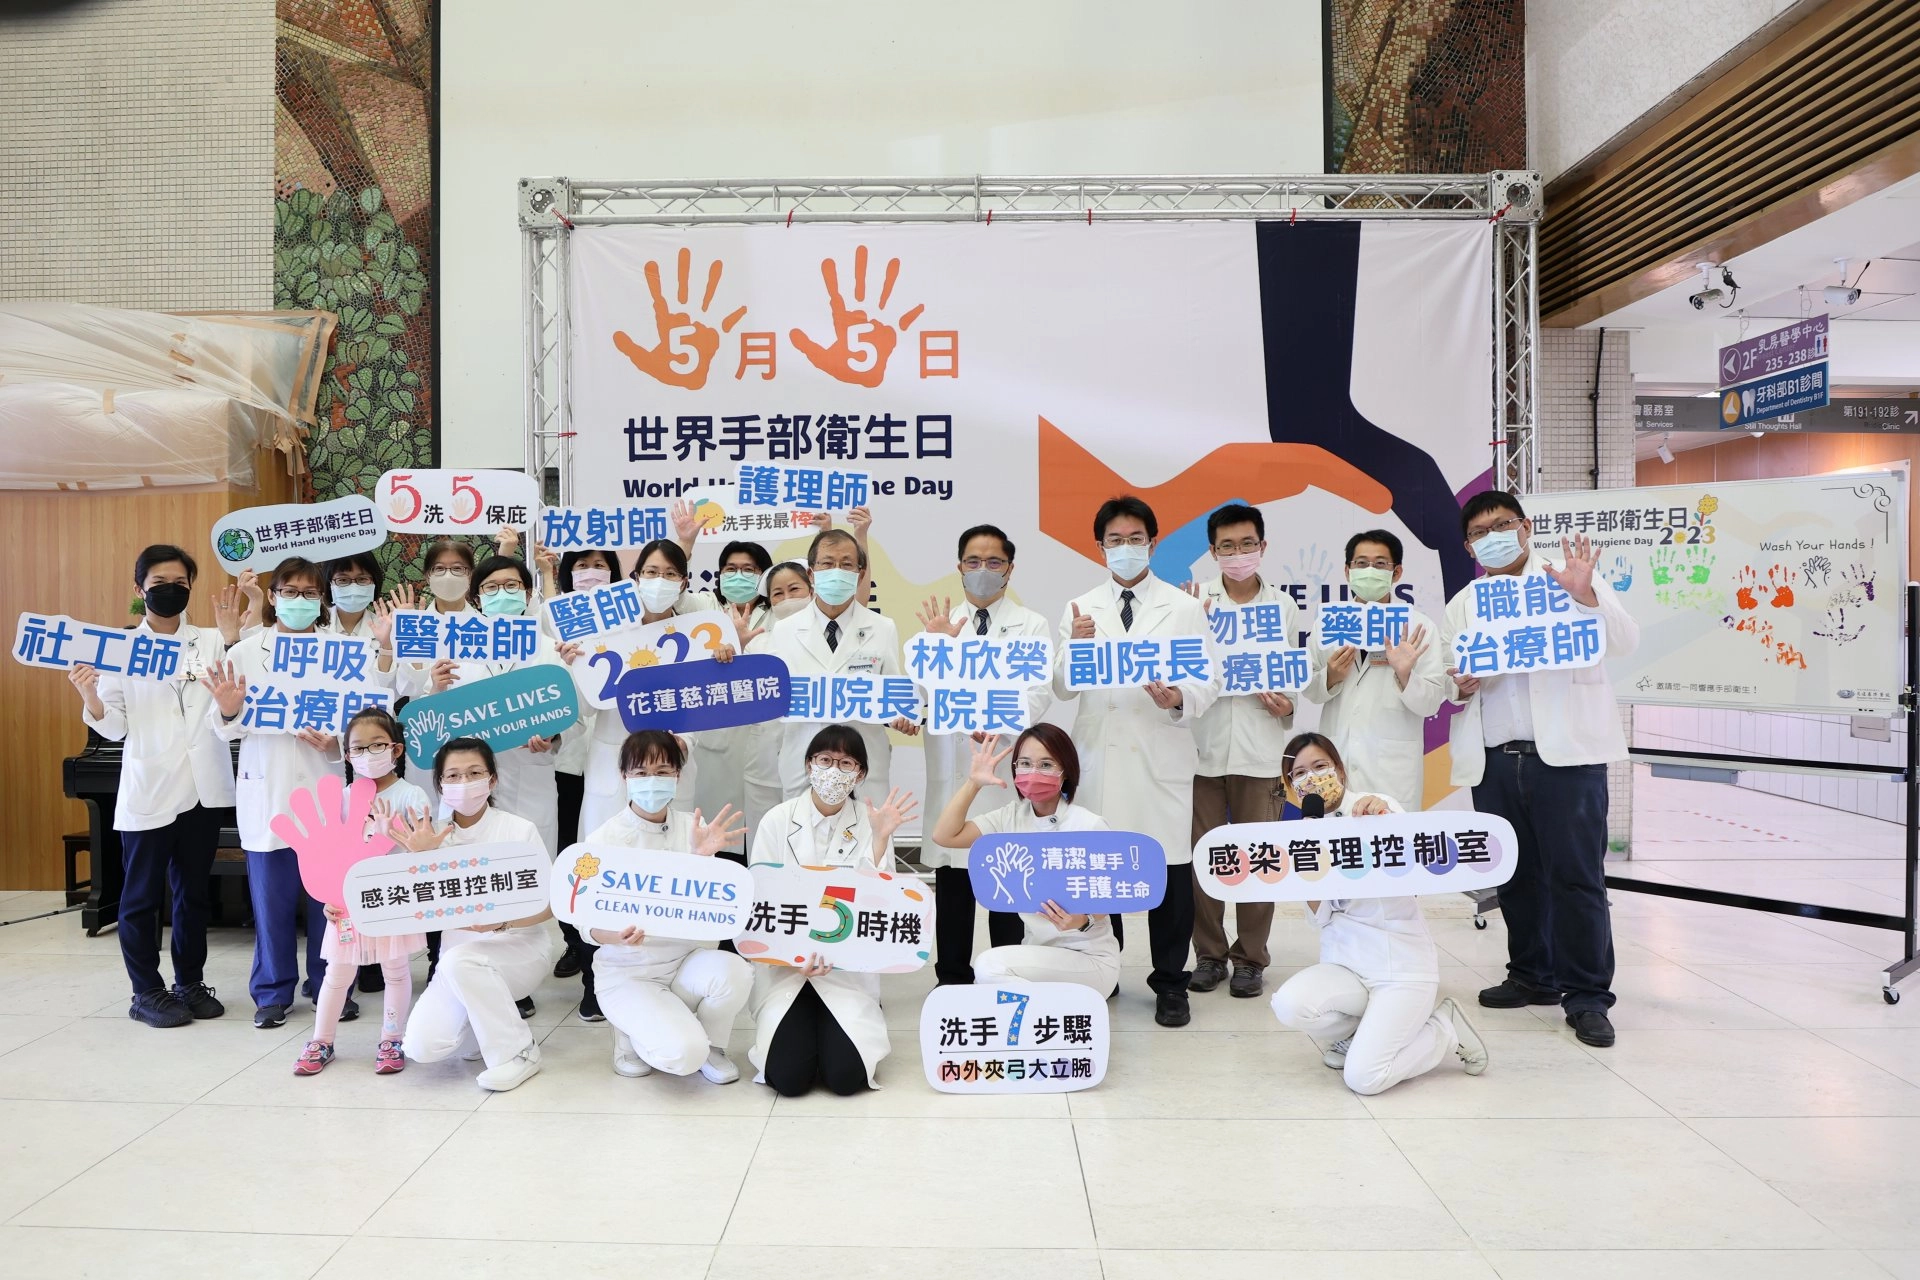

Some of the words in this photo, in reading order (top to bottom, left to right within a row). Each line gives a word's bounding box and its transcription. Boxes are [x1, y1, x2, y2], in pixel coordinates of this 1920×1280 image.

[1742, 348, 1758, 371] 2F
[1756, 371, 1823, 403] 牙科部B1診間
[1756, 402, 1783, 414] Department
[1784, 399, 1790, 407] of
[1790, 396, 1813, 405] Dentistry
[1758, 423, 1788, 431] Thoughts
[1843, 405, 1900, 418] 第191-192診
[623, 413, 953, 462] 世界手部衛生日
[738, 465, 869, 511] 護理師
[904, 476, 953, 501] Day
[255, 508, 374, 543] 世界手部衛生日
[260, 541, 288, 553] World
[290, 537, 315, 548] Hand
[317, 530, 356, 544] Hygiene
[358, 527, 376, 537] Day
[542, 507, 667, 548] 放射師
[722, 510, 814, 532] 洗手我最棒
[1532, 507, 1687, 536] 世界手部衛生日
[1534, 540, 1560, 549] World
[1591, 537, 1631, 548] Hygiene
[1634, 537, 1653, 547] Day
[1760, 540, 1792, 551] Wash
[1796, 540, 1824, 550] Your
[1829, 538, 1866, 550] Hands
[549, 582, 641, 642] 醫師
[1474, 575, 1571, 622] 職能
[395, 614, 537, 662] 醫檢師
[1207, 604, 1284, 645] 物理
[1321, 605, 1409, 647] 藥師
[19, 618, 182, 681] 社工師
[272, 636, 368, 683] 呼吸
[911, 638, 1048, 682] 林欣榮
[1069, 638, 1210, 686] 副院長
[1456, 618, 1600, 674] 治療師
[448, 701, 502, 729] SAVE
[505, 684, 561, 713] LIVES
[626, 676, 781, 716] 花蓮慈濟醫院
[784, 676, 920, 720] 副院長
[934, 688, 1026, 732] 院長
[493, 718, 528, 736] YOUR
[530, 706, 572, 726] HANDS
[1208, 830, 1491, 876] 感染管理控制室
[360, 869, 539, 909] 感染管理控制室
[601, 870, 663, 894] SAVE
[671, 878, 737, 902] LIVES
[1065, 876, 1150, 899] 手護生命
[594, 899, 640, 914] CLEAN
[645, 905, 684, 919] YOUR
[688, 910, 737, 925] HANDS
[745, 886, 921, 945] 洗手5時機
[939, 990, 1093, 1046] 洗手7步驟
[942, 1057, 1093, 1081] 內外夾弓大立腕
